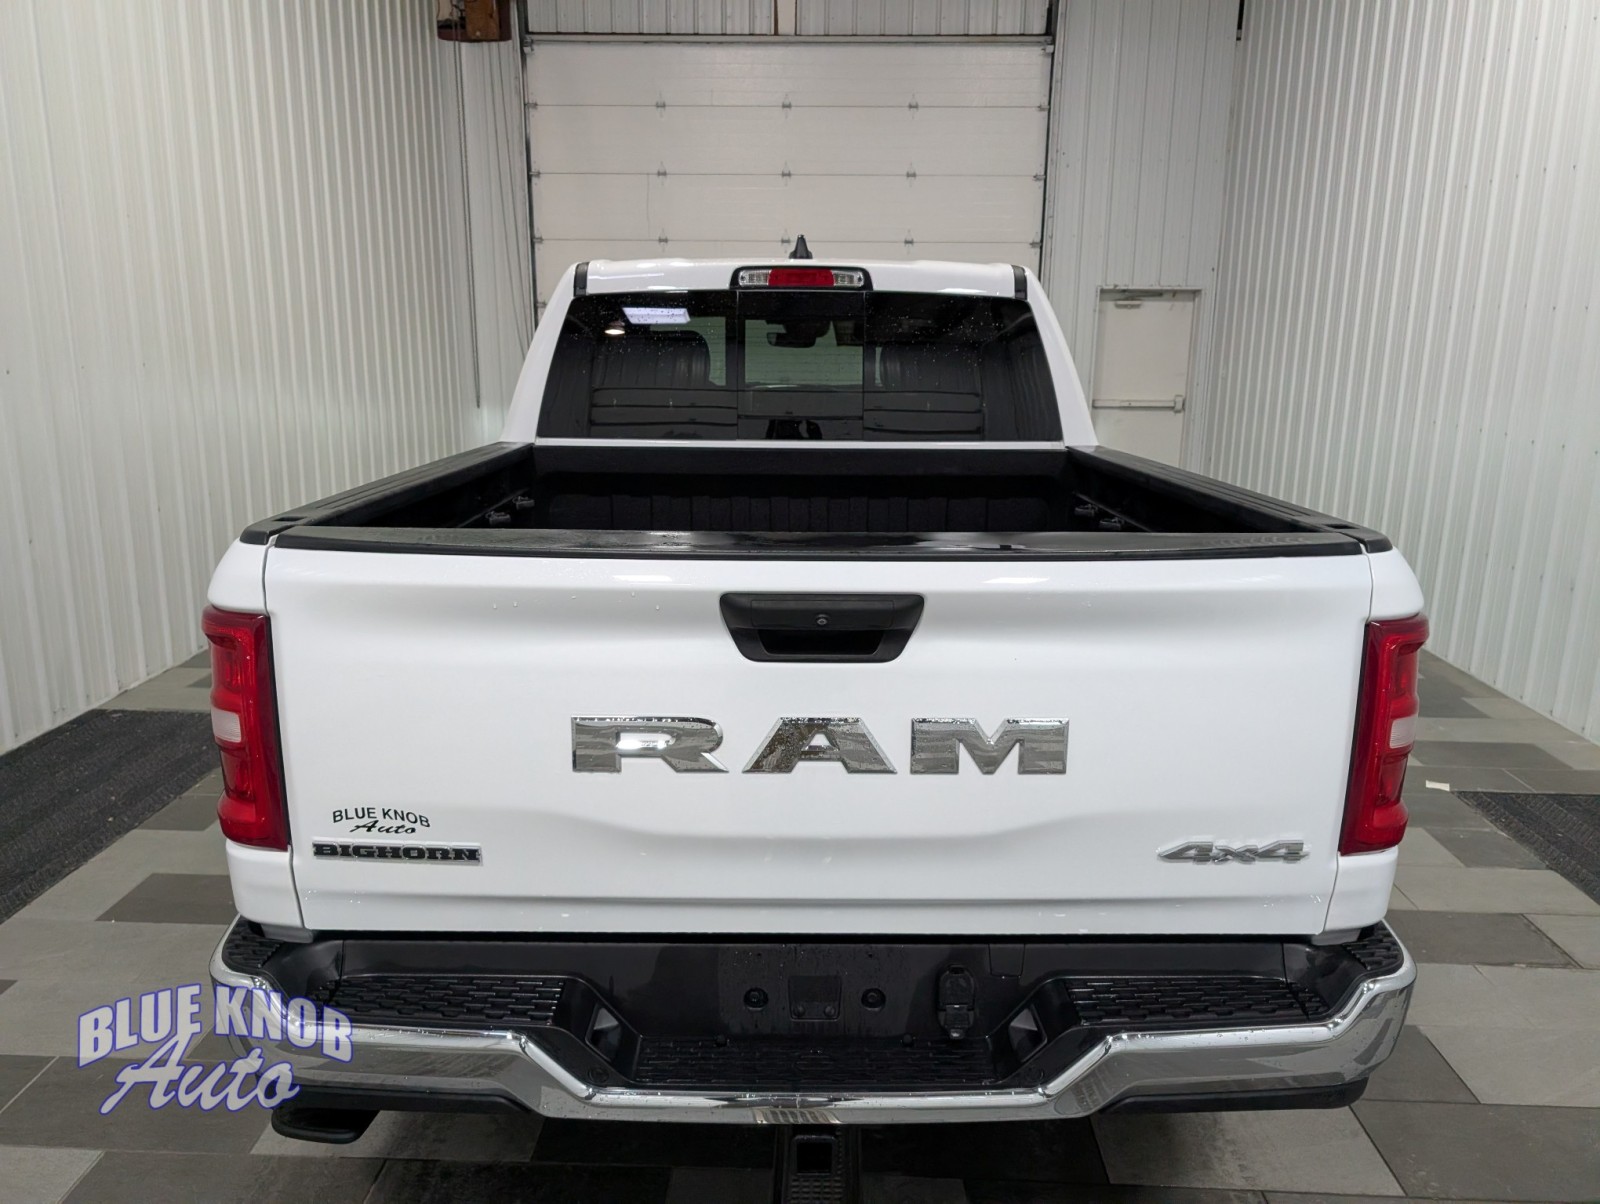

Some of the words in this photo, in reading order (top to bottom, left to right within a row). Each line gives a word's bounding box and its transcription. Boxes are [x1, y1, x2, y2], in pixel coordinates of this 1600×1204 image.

[571, 716, 1070, 775] RAM
[332, 807, 377, 823] BLUE
[382, 808, 431, 828] KNOB
[350, 820, 417, 834] Auto
[312, 841, 482, 863] BIGHORN
[1158, 840, 1308, 864] 4x4
